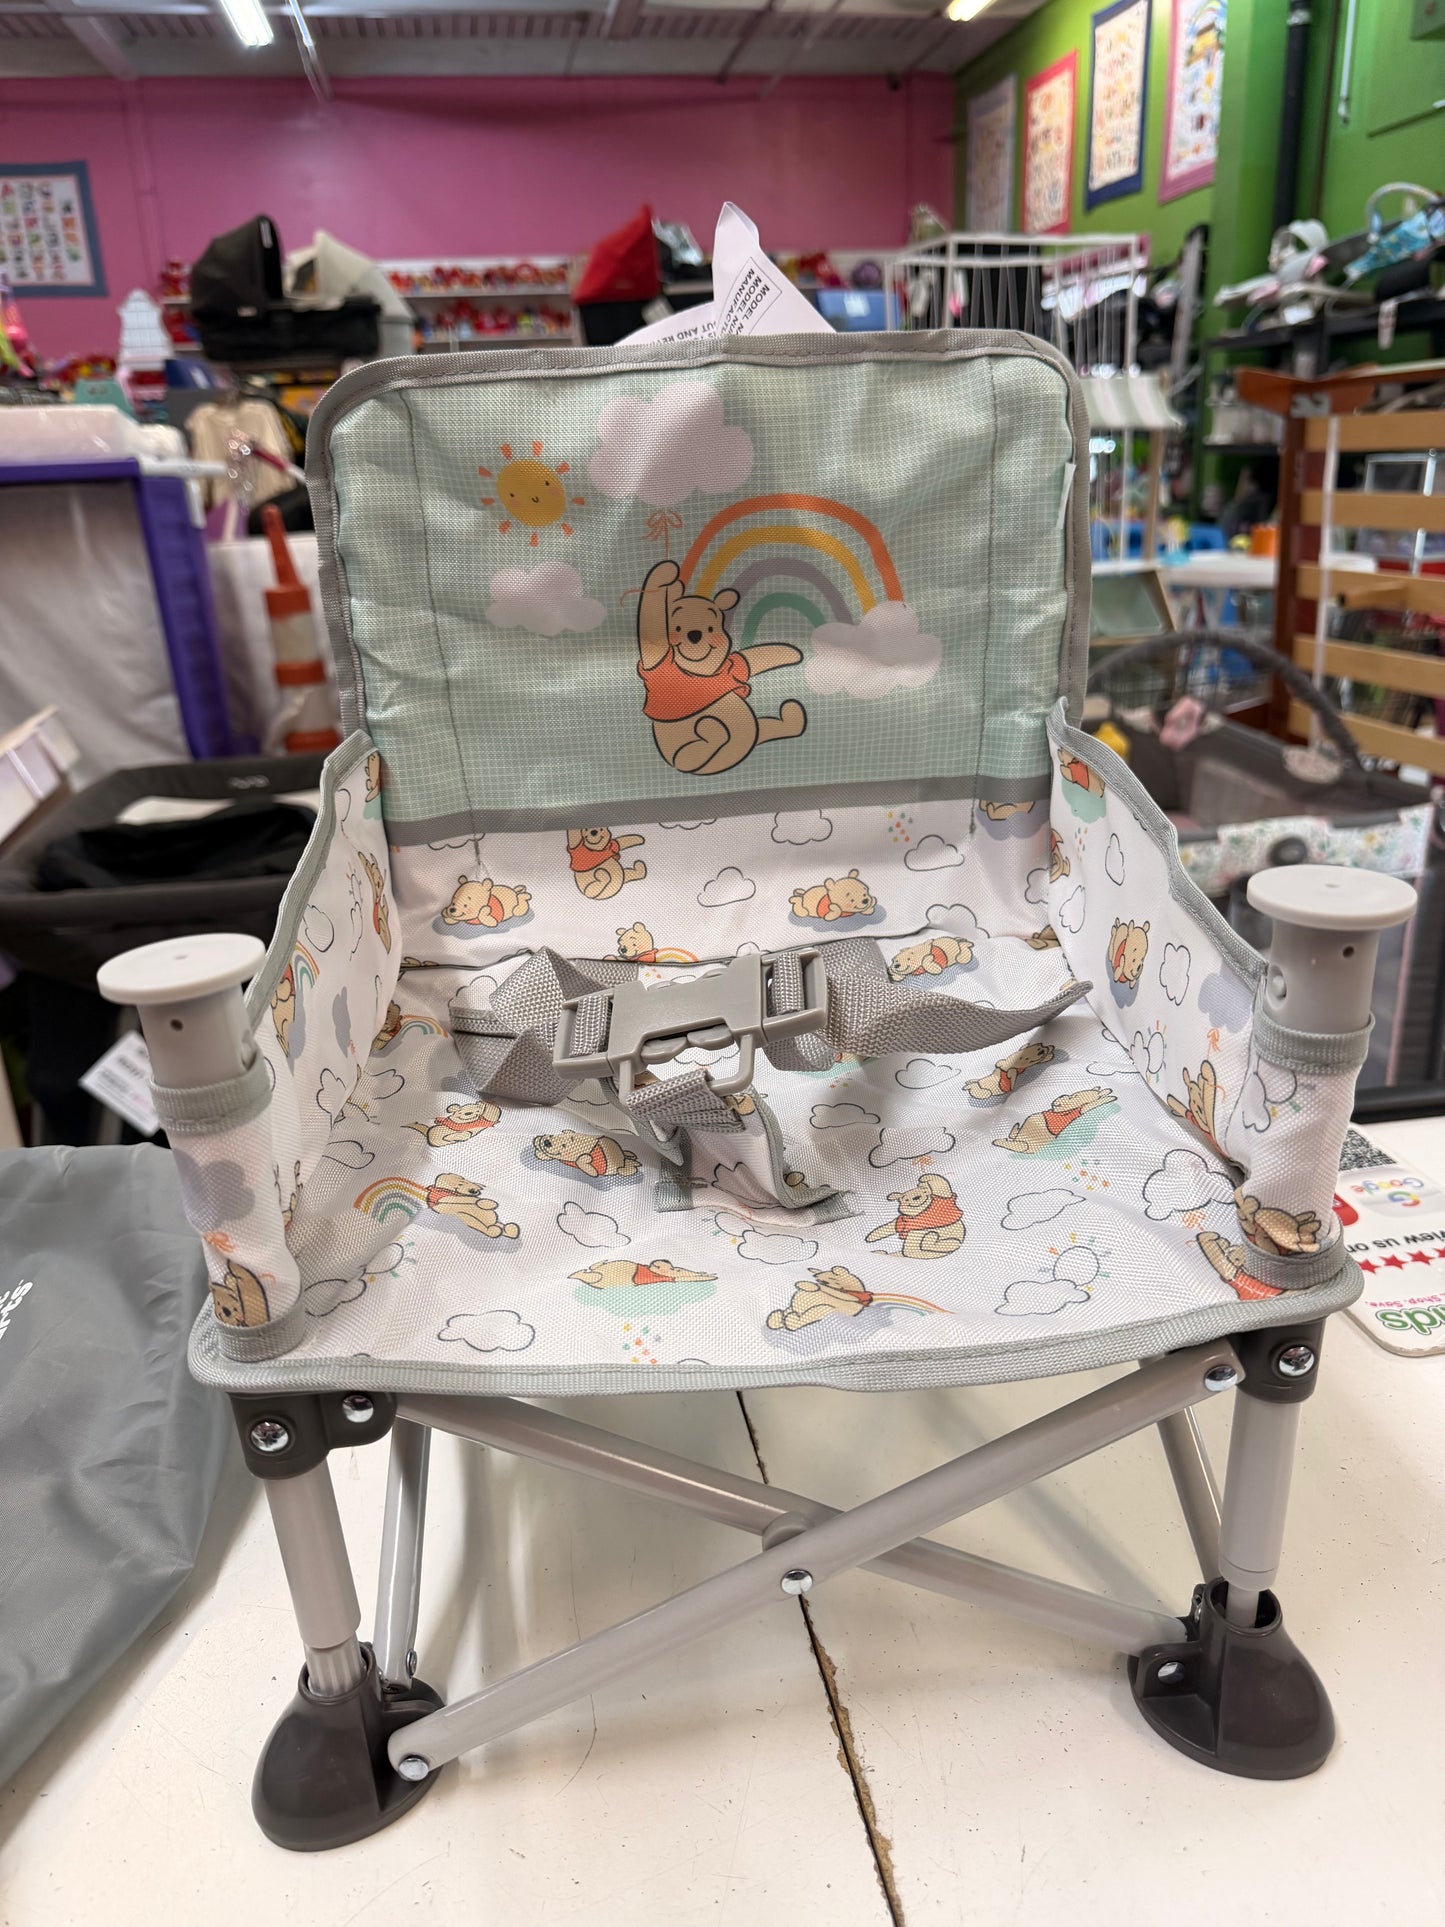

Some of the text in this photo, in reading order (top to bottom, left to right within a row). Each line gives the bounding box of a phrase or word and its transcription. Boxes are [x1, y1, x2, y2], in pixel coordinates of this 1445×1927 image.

[737, 276, 762, 313] MODEL
[742, 284, 770, 321] MODEL
[677, 327, 698, 340] AND
[1351, 1177, 1424, 1195] Google
[1373, 1238, 1401, 1249] us
